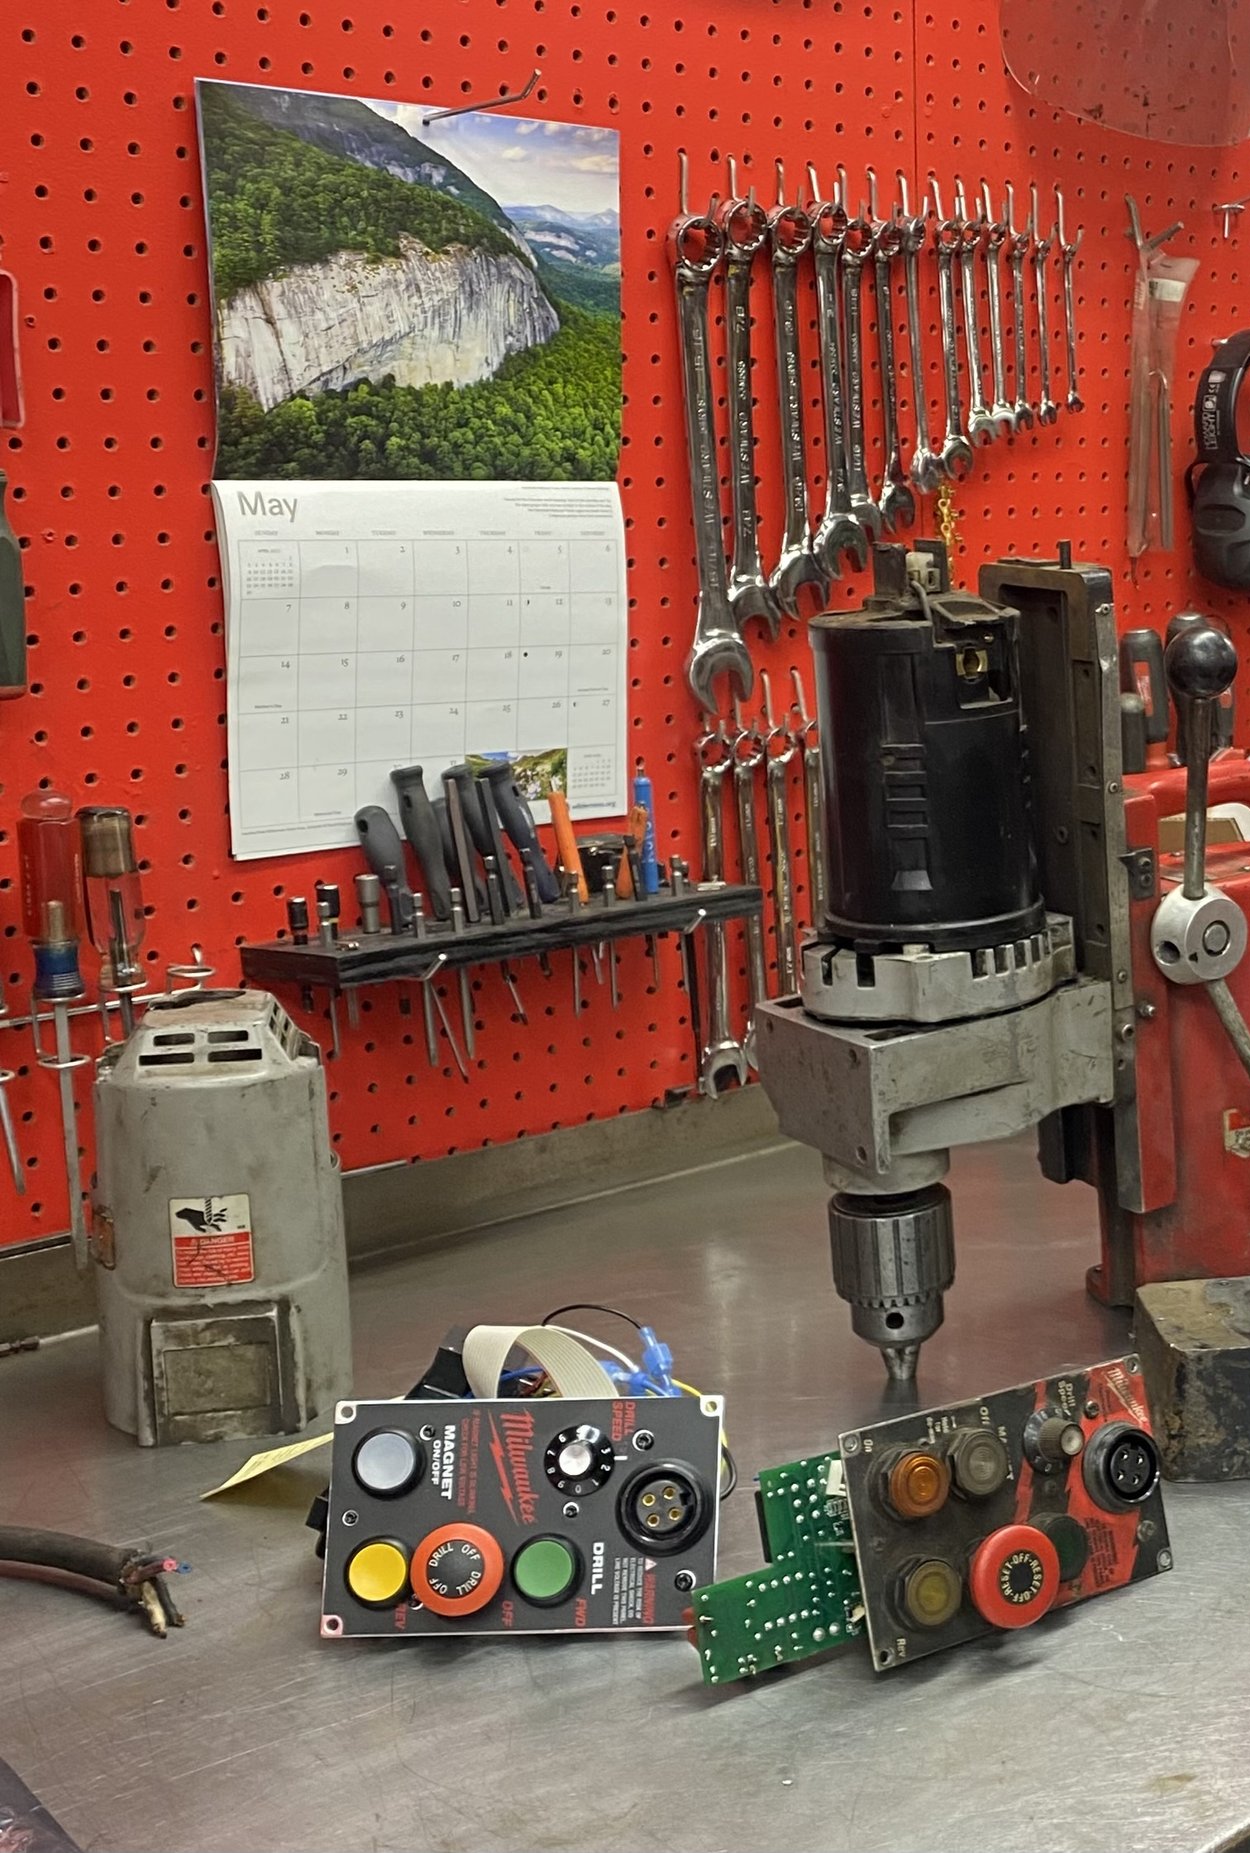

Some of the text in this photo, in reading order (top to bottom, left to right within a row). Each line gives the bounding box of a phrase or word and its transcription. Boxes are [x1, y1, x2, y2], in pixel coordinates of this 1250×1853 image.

[831, 381, 843, 445] WESTWARD
[850, 370, 861, 429] WESTWARD
[789, 395, 802, 461] WESTWARD
[737, 411, 750, 484] WESTWARD
[699, 444, 715, 524] WESTWARD
[237, 491, 298, 523] May
[452, 600, 462, 608] 10
[555, 598, 564, 606] 12
[281, 648, 612, 669] 14 15 16 17 18 19 20
[280, 698, 611, 725] 21 22 23 24 25 26 27
[279, 768, 348, 781] 28 29
[1065, 1383, 1077, 1408] Drill
[1106, 1366, 1148, 1422] Milwaukee
[611, 1401, 624, 1442] SPEED
[623, 1401, 636, 1436] DRILL
[979, 1406, 991, 1426] Off
[863, 1439, 874, 1453] On
[431, 1440, 442, 1486] ON/OFF
[440, 1425, 456, 1500] MAGNET
[500, 1408, 540, 1525] Milwaukee
[600, 1464, 611, 1472] 2
[428, 1542, 454, 1567] DRILL
[460, 1544, 480, 1560] OFF
[590, 1542, 605, 1596] DRILL
[428, 1578, 448, 1594] OFF
[455, 1571, 481, 1596] DRILL
[575, 1598, 587, 1627] FWD
[643, 1573, 656, 1624] WARNING
[395, 1603, 408, 1629] REV
[501, 1600, 514, 1627] OFF
[896, 1638, 907, 1658] Rev
